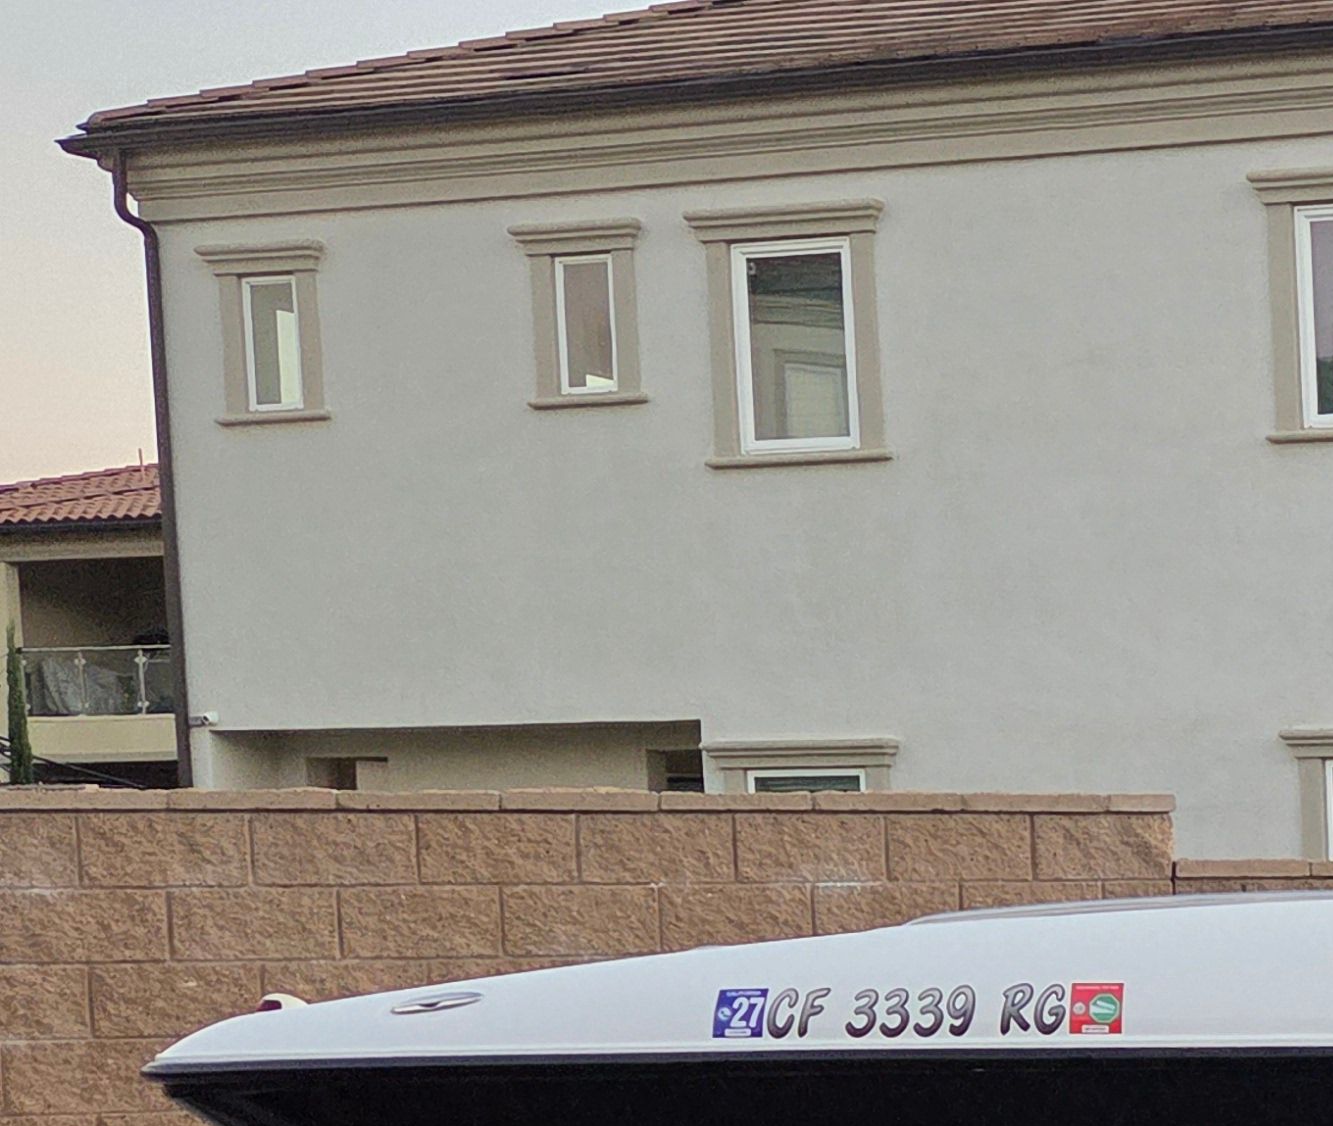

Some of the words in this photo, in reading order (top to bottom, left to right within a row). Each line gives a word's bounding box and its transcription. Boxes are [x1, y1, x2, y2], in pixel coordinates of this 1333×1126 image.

[729, 996, 765, 1028] 27
[766, 986, 832, 1039] CF
[844, 984, 976, 1038] 3339
[999, 982, 1067, 1036] RG
